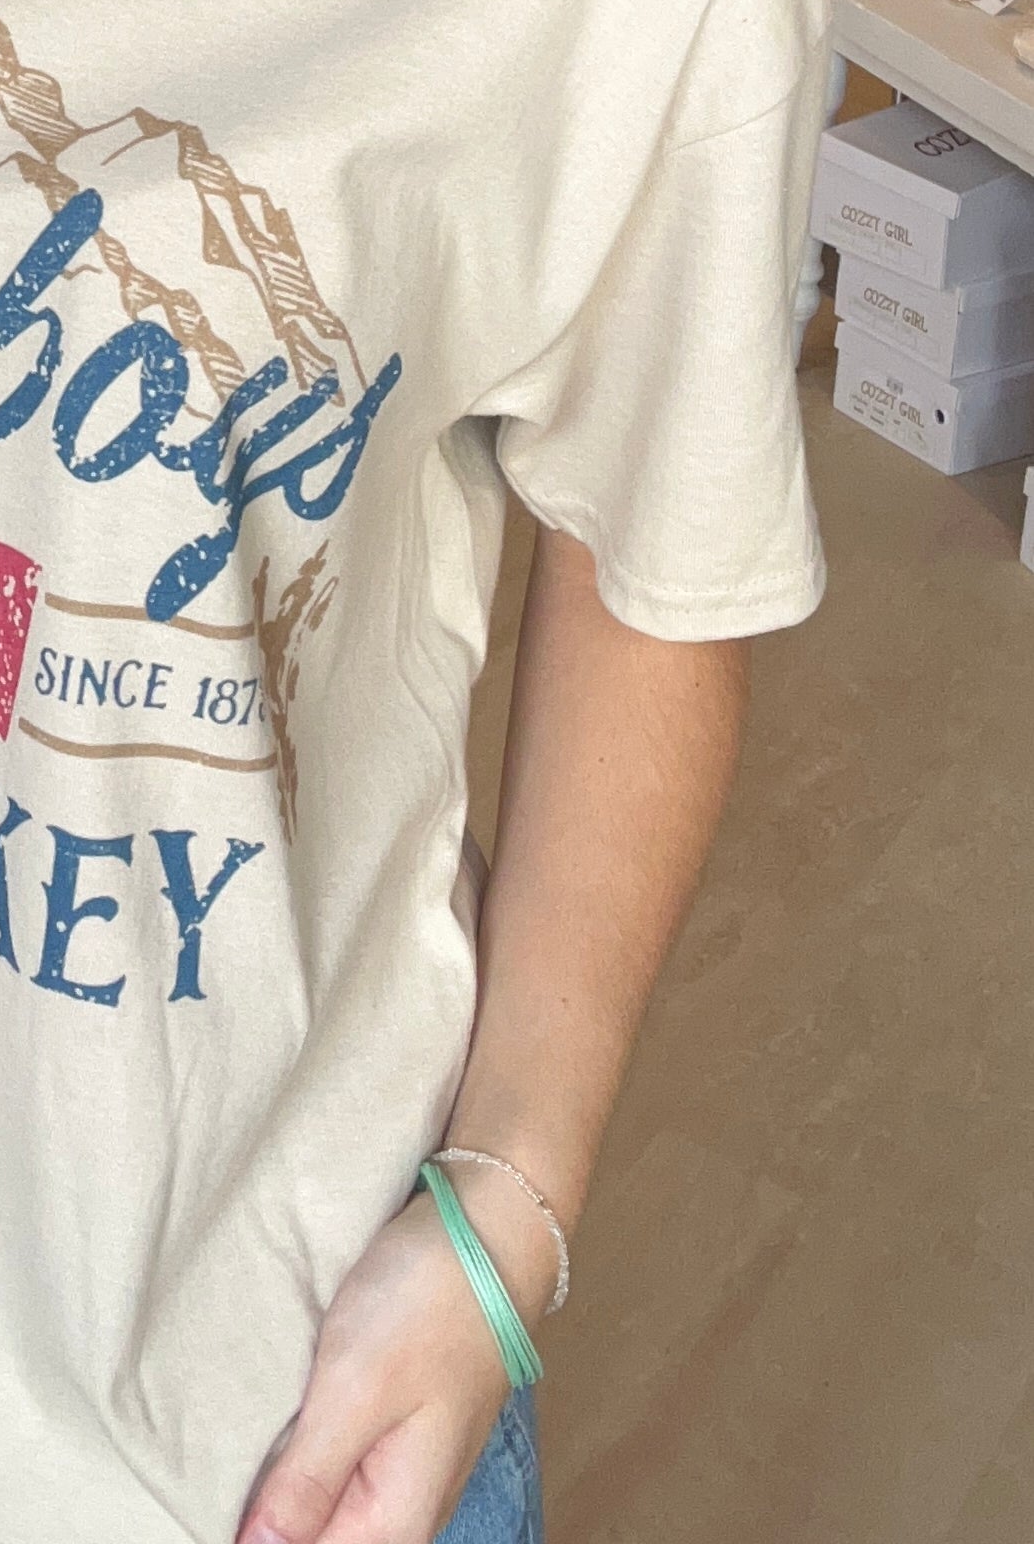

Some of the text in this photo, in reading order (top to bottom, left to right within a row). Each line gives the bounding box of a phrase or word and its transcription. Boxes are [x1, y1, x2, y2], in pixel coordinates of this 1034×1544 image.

[841, 205, 913, 246] COZZY GIRL
[902, 307, 928, 333] GIRL
[899, 401, 925, 428] GIRL
[35, 646, 173, 710] SINCE
